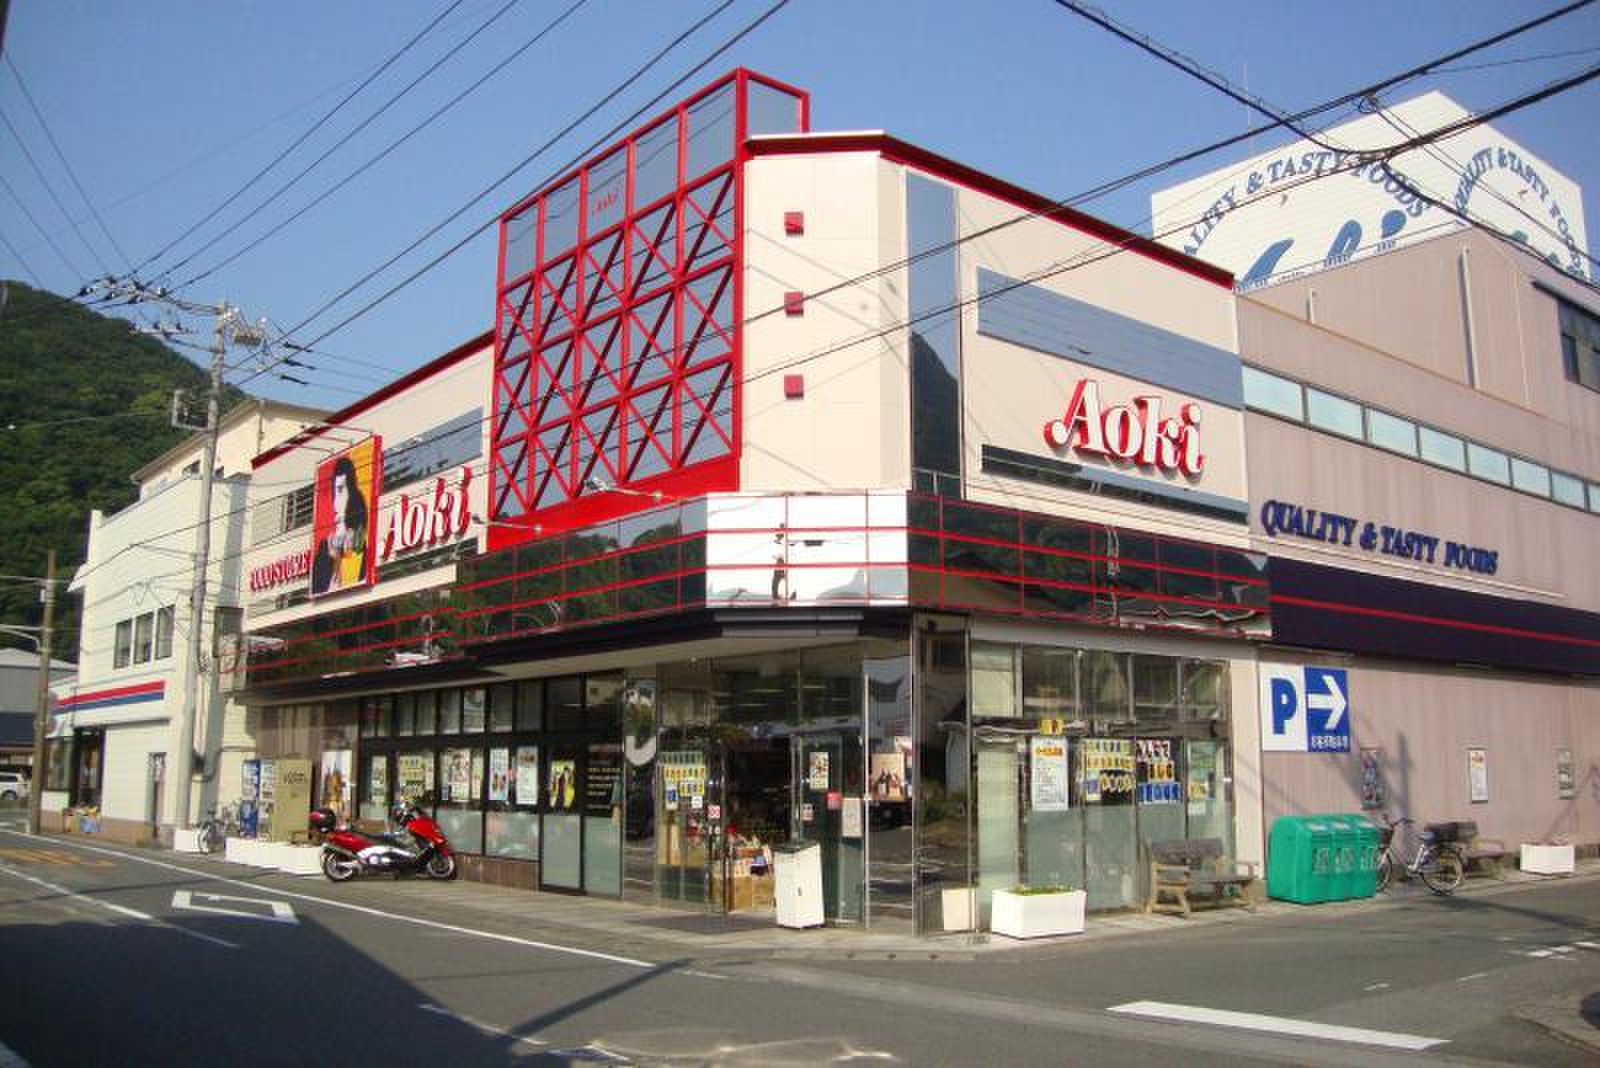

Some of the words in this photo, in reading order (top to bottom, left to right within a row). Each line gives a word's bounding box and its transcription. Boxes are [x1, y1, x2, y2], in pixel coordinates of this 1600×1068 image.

[1247, 170, 1264, 194] &
[1267, 150, 1346, 183] TASTY
[1043, 378, 1204, 477] Aoki
[377, 467, 472, 560] Aoki
[1260, 499, 1357, 547] QUALITY
[1359, 521, 1377, 549] &
[1381, 525, 1440, 563] TASTY
[1443, 540, 1498, 574] FOODS
[1271, 678, 1297, 734] P
